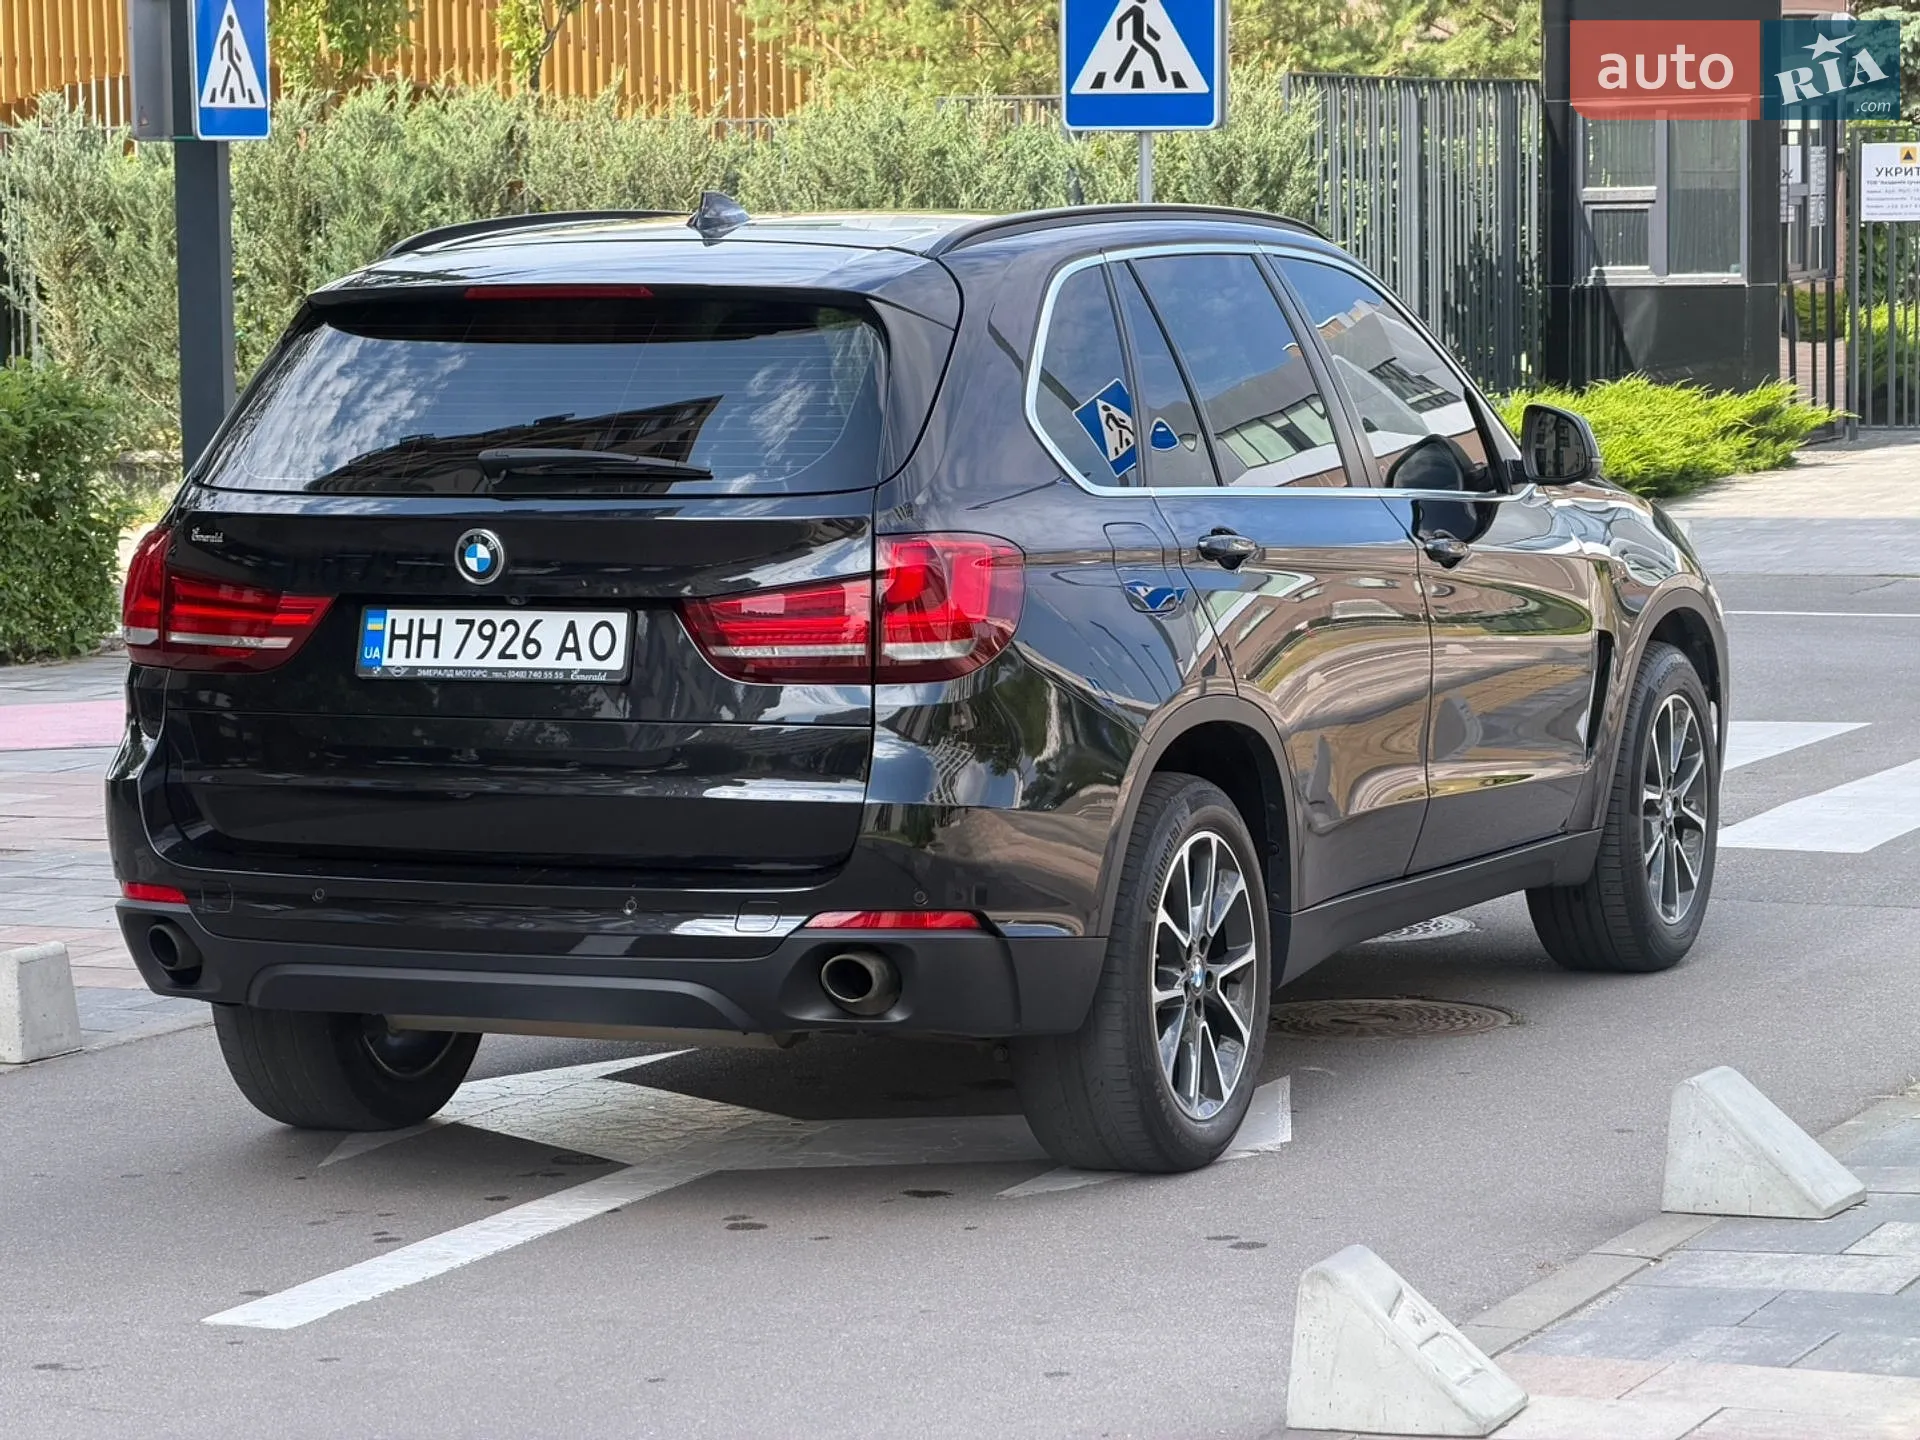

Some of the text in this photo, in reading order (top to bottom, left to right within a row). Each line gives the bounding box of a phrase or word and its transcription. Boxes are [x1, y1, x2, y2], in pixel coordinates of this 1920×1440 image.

[387, 618, 617, 662] HH 7926 AO
[364, 647, 381, 660] UA
[417, 669, 454, 678] ЭМЕРАЛД
[455, 669, 488, 678] МОТОРС
[543, 671, 553, 679] 55
[554, 671, 564, 679] 55
[570, 669, 608, 681] Emerald
[1147, 818, 1183, 913] Continental
